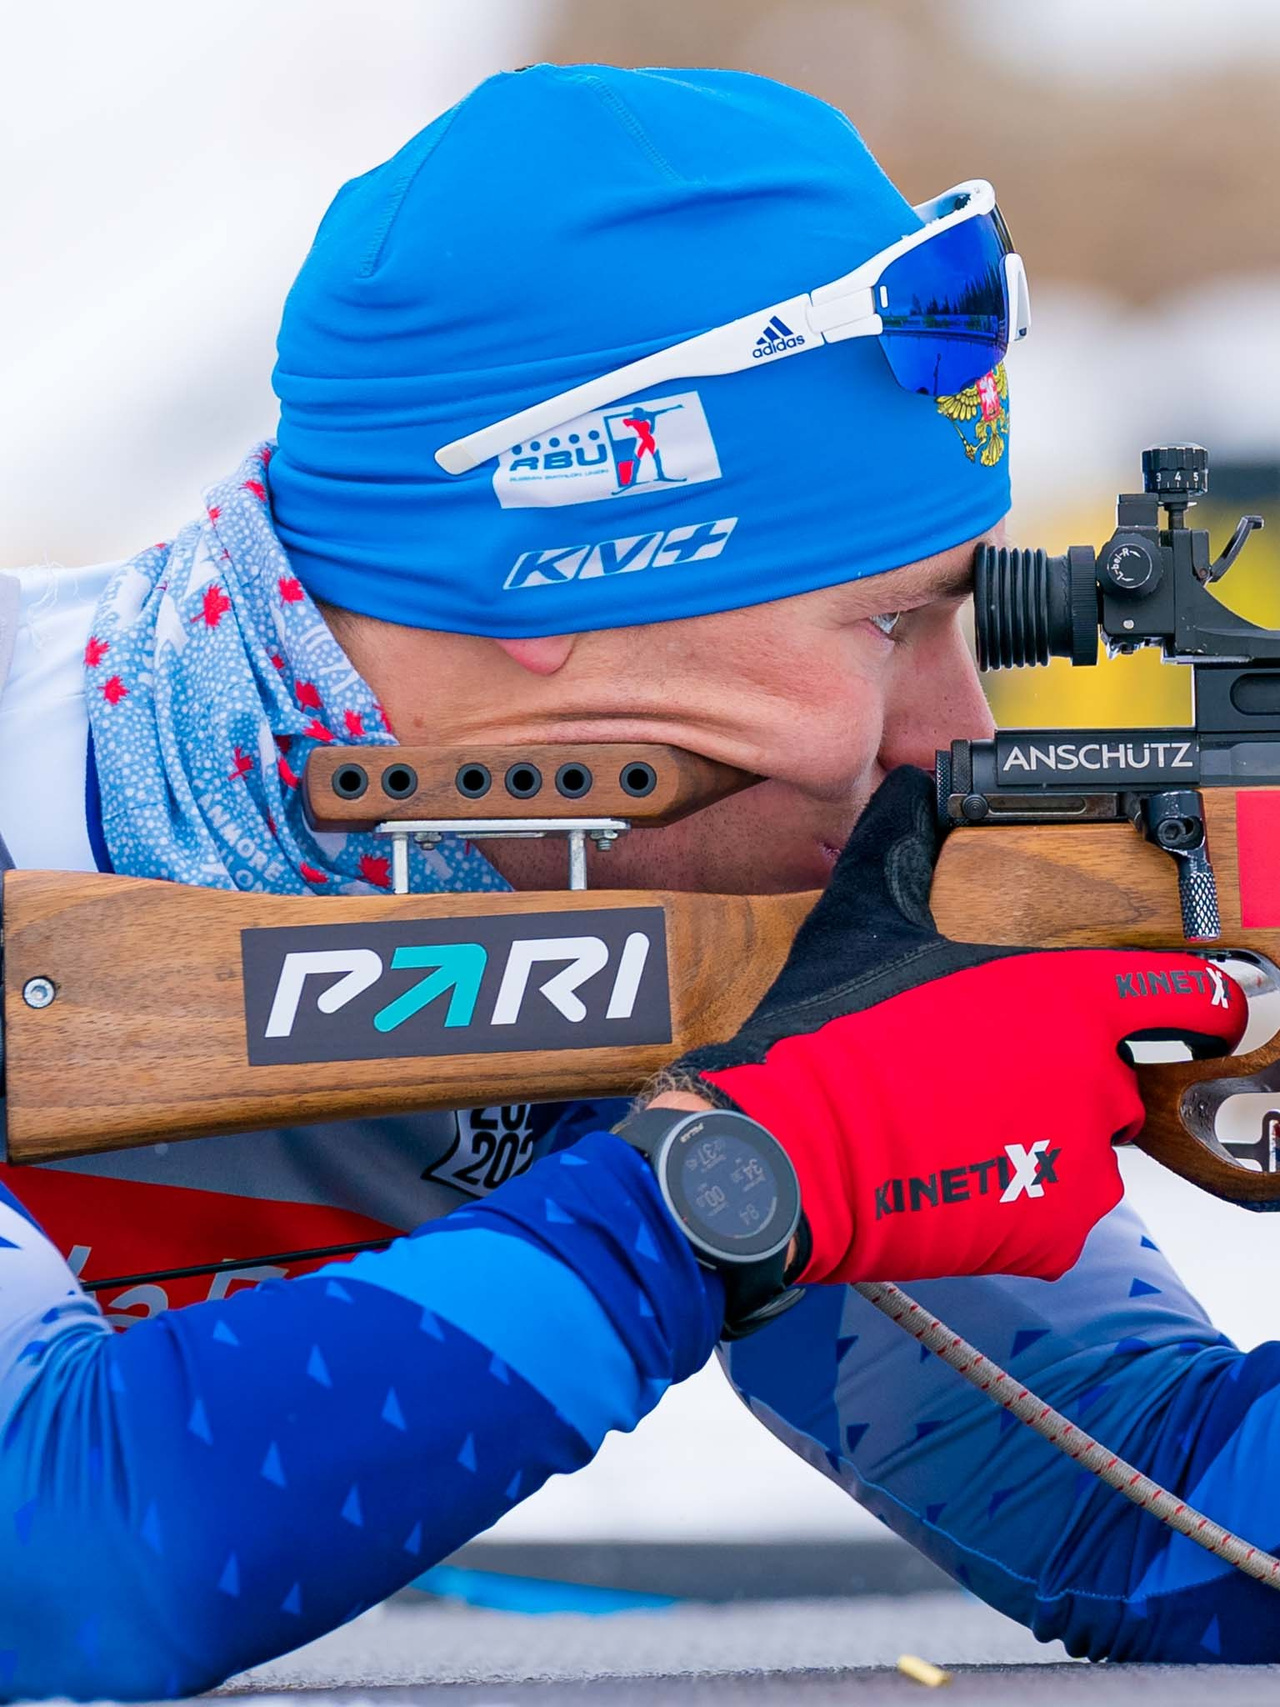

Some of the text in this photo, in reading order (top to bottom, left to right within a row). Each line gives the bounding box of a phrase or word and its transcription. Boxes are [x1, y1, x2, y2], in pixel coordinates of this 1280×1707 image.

[752, 335, 805, 358] adidas
[509, 443, 608, 471] RBU
[1156, 471, 1199, 482] 3 4 5
[1003, 743, 1193, 771] ANSCHÜTZ
[264, 932, 650, 1038] PARI
